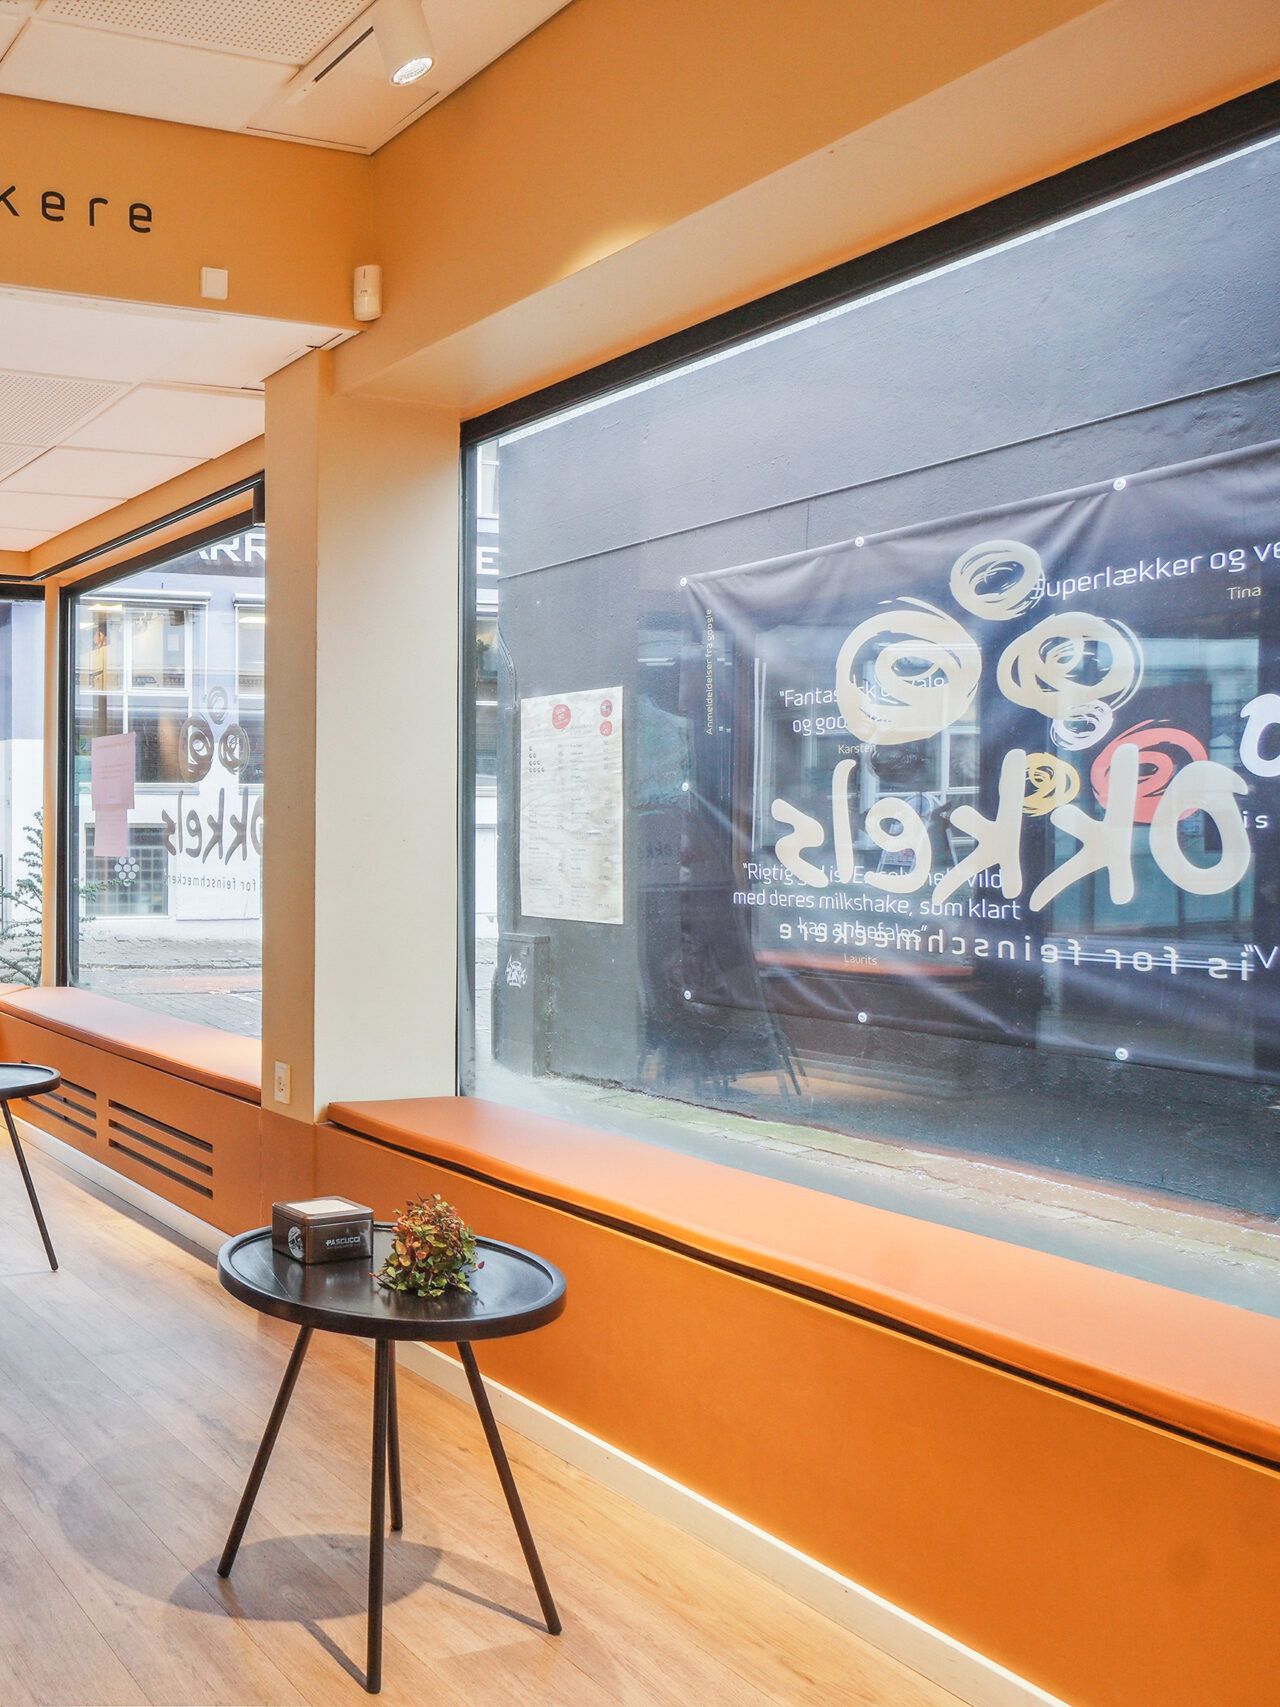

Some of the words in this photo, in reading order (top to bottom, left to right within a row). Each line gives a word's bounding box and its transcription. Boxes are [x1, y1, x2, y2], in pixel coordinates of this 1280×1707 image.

[1210, 548, 1247, 573] og
[1227, 585, 1262, 600] Tina
[792, 718, 813, 737] og
[838, 740, 877, 756] Karsten
[1243, 810, 1268, 829] is
[732, 889, 766, 906] med
[768, 890, 815, 909] deres
[818, 892, 914, 917] milkshake,
[968, 898, 1022, 920] klart
[843, 953, 879, 967] Laurits
[325, 1236, 361, 1247] PASCUCCI
